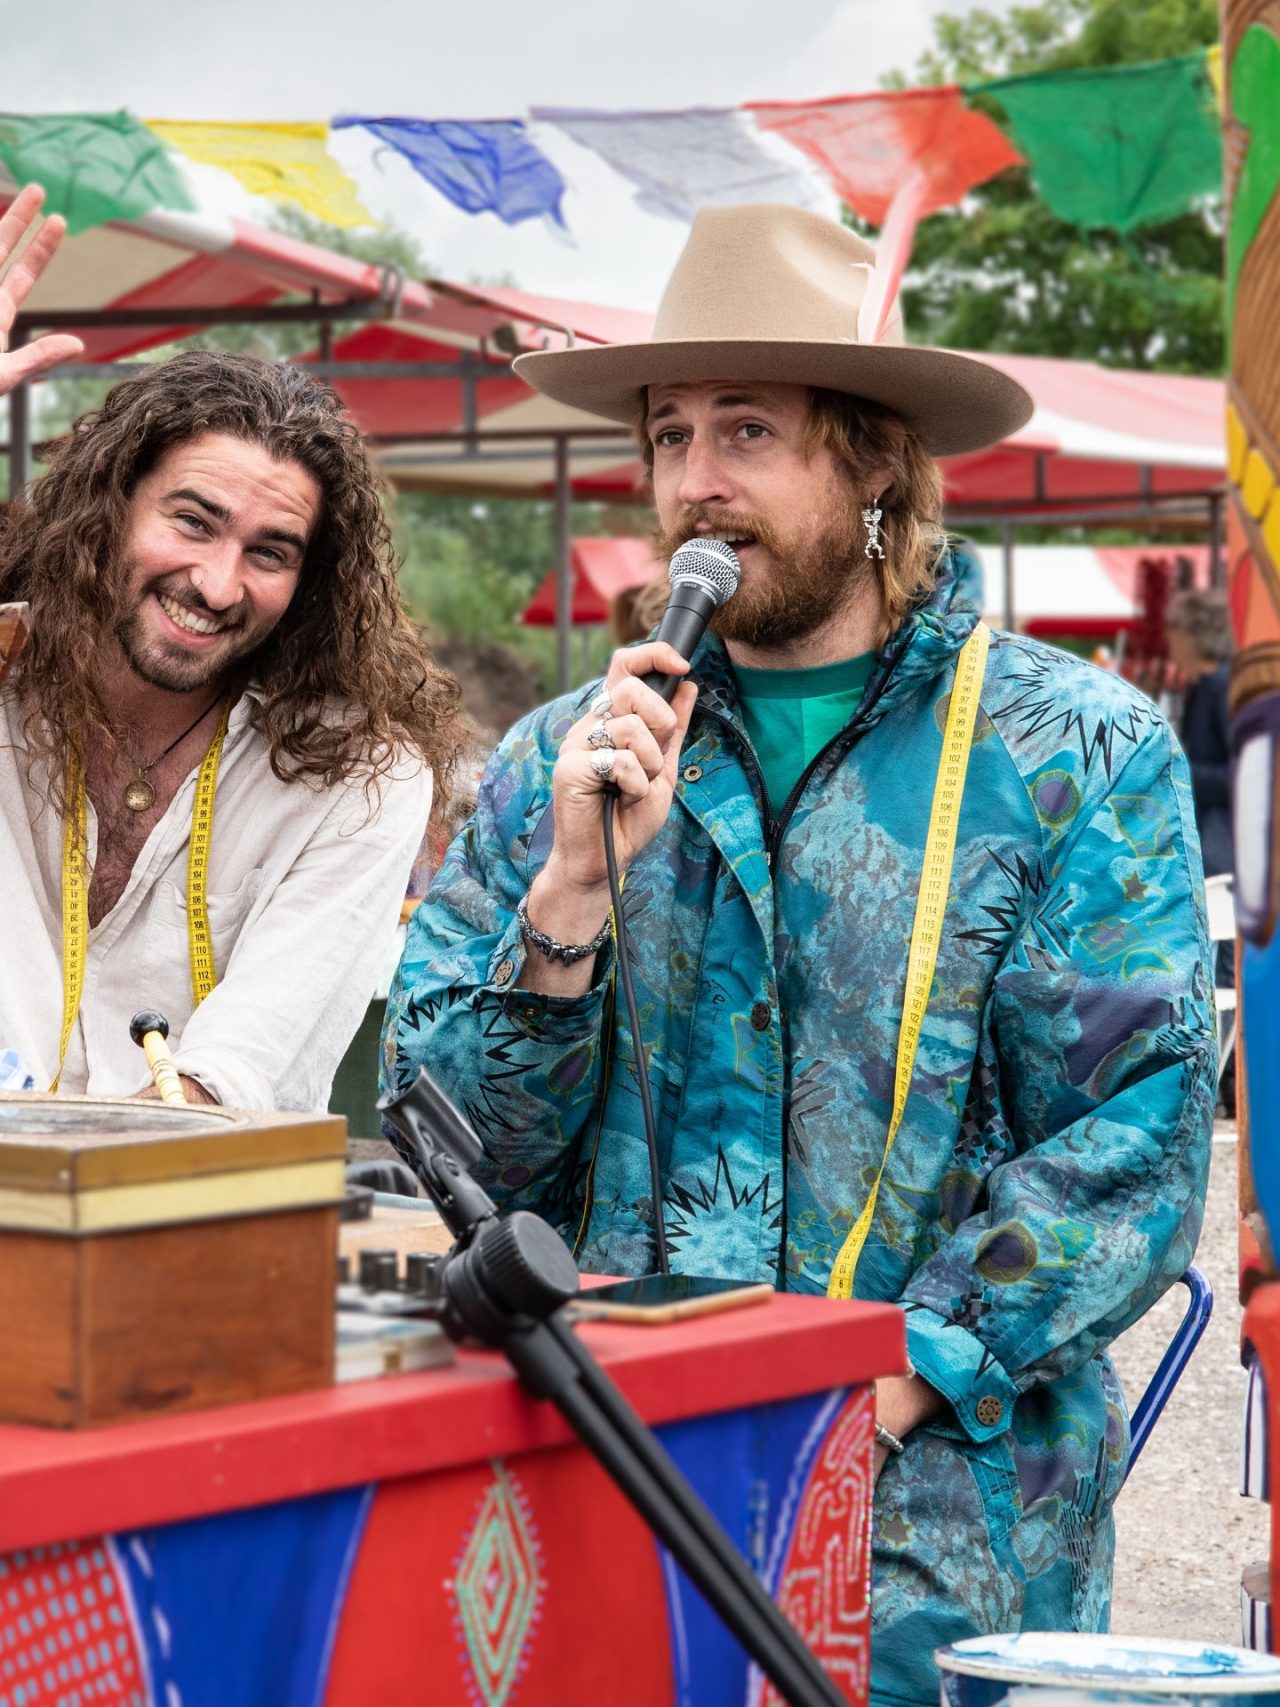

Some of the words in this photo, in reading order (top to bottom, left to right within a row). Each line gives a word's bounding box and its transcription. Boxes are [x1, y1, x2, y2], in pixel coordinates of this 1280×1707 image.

[968, 655, 977, 663] 93
[967, 664, 975, 672] 94
[965, 675, 973, 683] 95
[962, 685, 971, 693] 96
[960, 696, 969, 704] 97
[956, 718, 965, 726] 99
[953, 730, 965, 738] 100
[951, 742, 962, 750] 101
[949, 754, 961, 762] 102
[947, 767, 959, 775] 103
[204, 773, 211, 781] 96
[945, 779, 956, 787] 104
[202, 785, 209, 793] 97
[943, 791, 955, 799] 105
[201, 797, 209, 805] 98
[940, 803, 953, 811] 106
[200, 810, 207, 818] 99
[938, 816, 951, 824] 107
[198, 822, 207, 830] 100
[936, 829, 949, 837] 108
[935, 841, 947, 849] 109
[195, 846, 204, 854] 102
[933, 855, 945, 863] 110
[193, 870, 202, 878] 104
[931, 868, 942, 876] 111
[192, 883, 201, 891] 105
[929, 881, 941, 889] 112
[192, 896, 201, 904] 106
[927, 893, 939, 901] 113
[192, 908, 202, 916] 107
[925, 906, 937, 914] 114
[194, 921, 204, 929] 108
[923, 920, 935, 928] 115
[195, 933, 205, 942] 109
[921, 933, 933, 942] 116
[196, 946, 207, 954] 110
[919, 946, 931, 955] 117
[917, 960, 929, 969] 118
[198, 971, 209, 979] 112
[916, 973, 927, 982] 119
[914, 986, 925, 995] 120
[912, 999, 922, 1008] 121
[910, 1013, 920, 1022] 122
[907, 1026, 916, 1036] 123
[904, 1041, 912, 1050] 124
